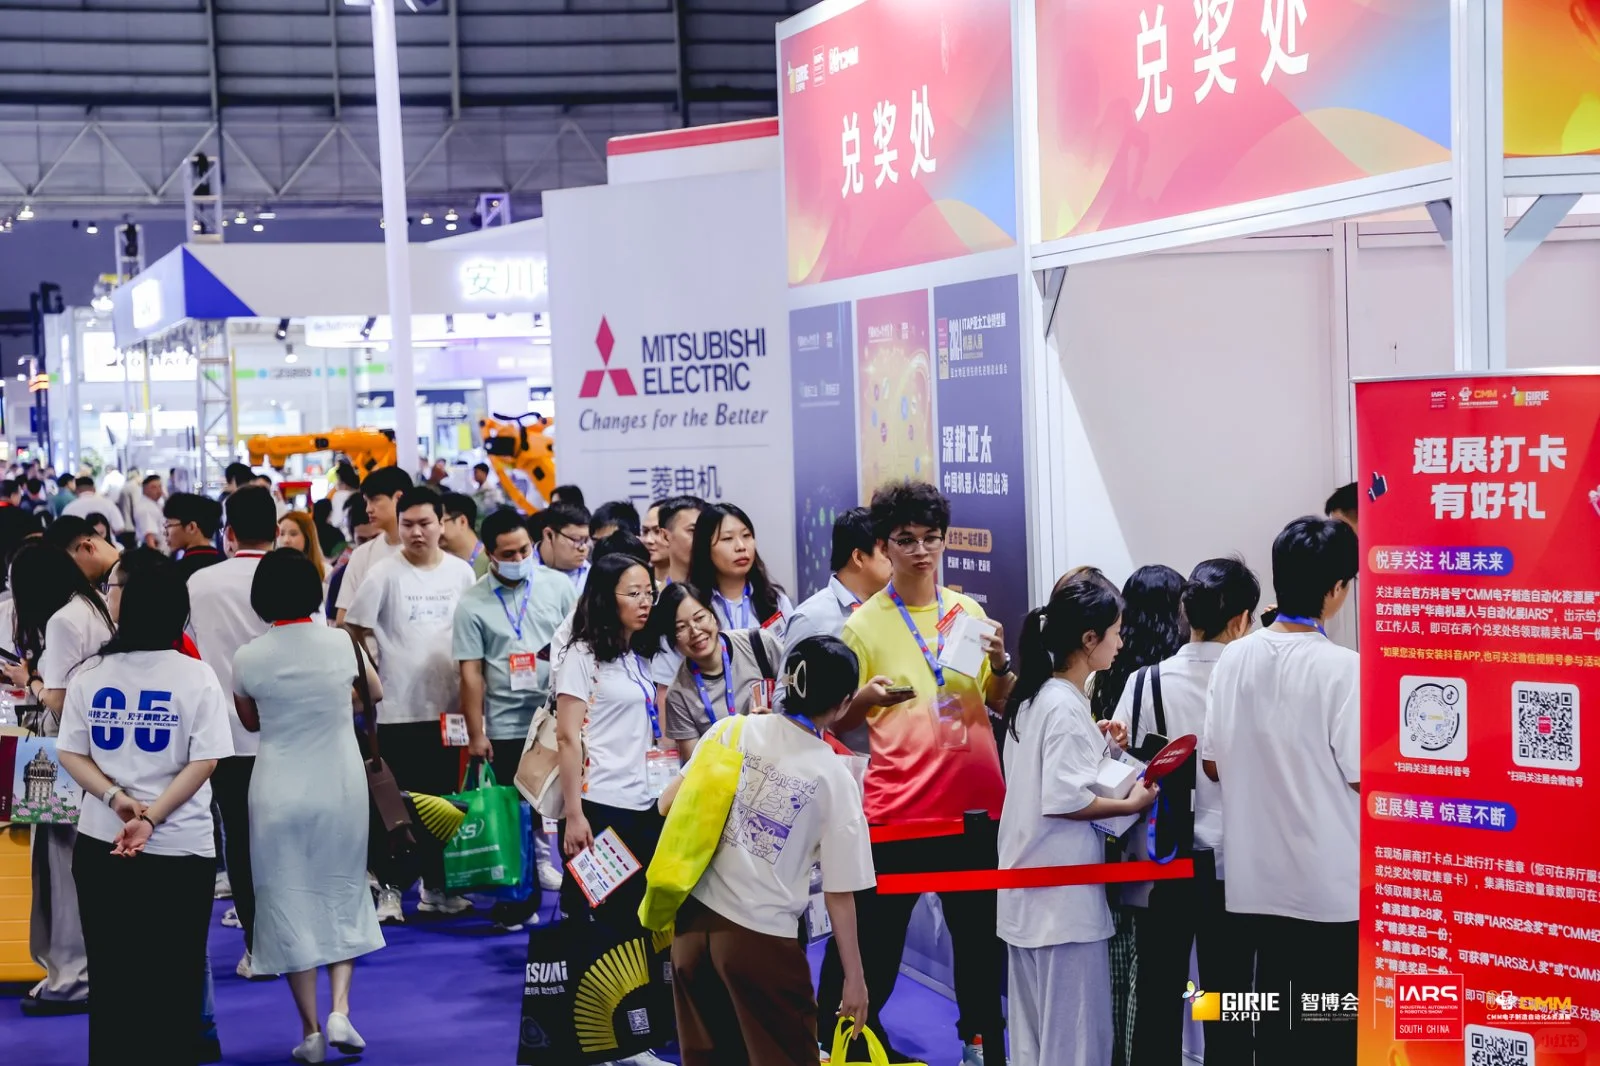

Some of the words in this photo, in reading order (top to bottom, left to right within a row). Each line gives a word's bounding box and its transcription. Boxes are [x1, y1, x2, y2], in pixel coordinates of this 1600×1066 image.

[1135, 0, 1309, 122] 兑奖处
[841, 84, 936, 199] 兑奖处
[466, 263, 548, 296] 安川
[642, 327, 766, 363] MITSUBISHI
[643, 362, 750, 395] ELECTRIC
[1525, 390, 1549, 401] GIRIE
[579, 408, 647, 434] Changes
[652, 409, 678, 431] for
[683, 408, 709, 427] the
[715, 403, 769, 426] Better
[942, 424, 992, 464] 深耕亚太
[1413, 434, 1568, 475] 逛展打卡
[628, 465, 722, 500] 三菱电机
[944, 471, 1009, 496] 中国机器人组团出海
[1431, 482, 1546, 520] 有好礼
[1376, 551, 1434, 572] 悦享关注
[1439, 551, 1504, 572] 礼遇未来
[1375, 796, 1435, 820] 逛展集章
[1440, 801, 1506, 828] 惊喜不断
[1375, 846, 1600, 883] 在现场展商打卡点上进行打卡盖章（您可在序厅服
[1375, 883, 1443, 903] 处领取精美礼品
